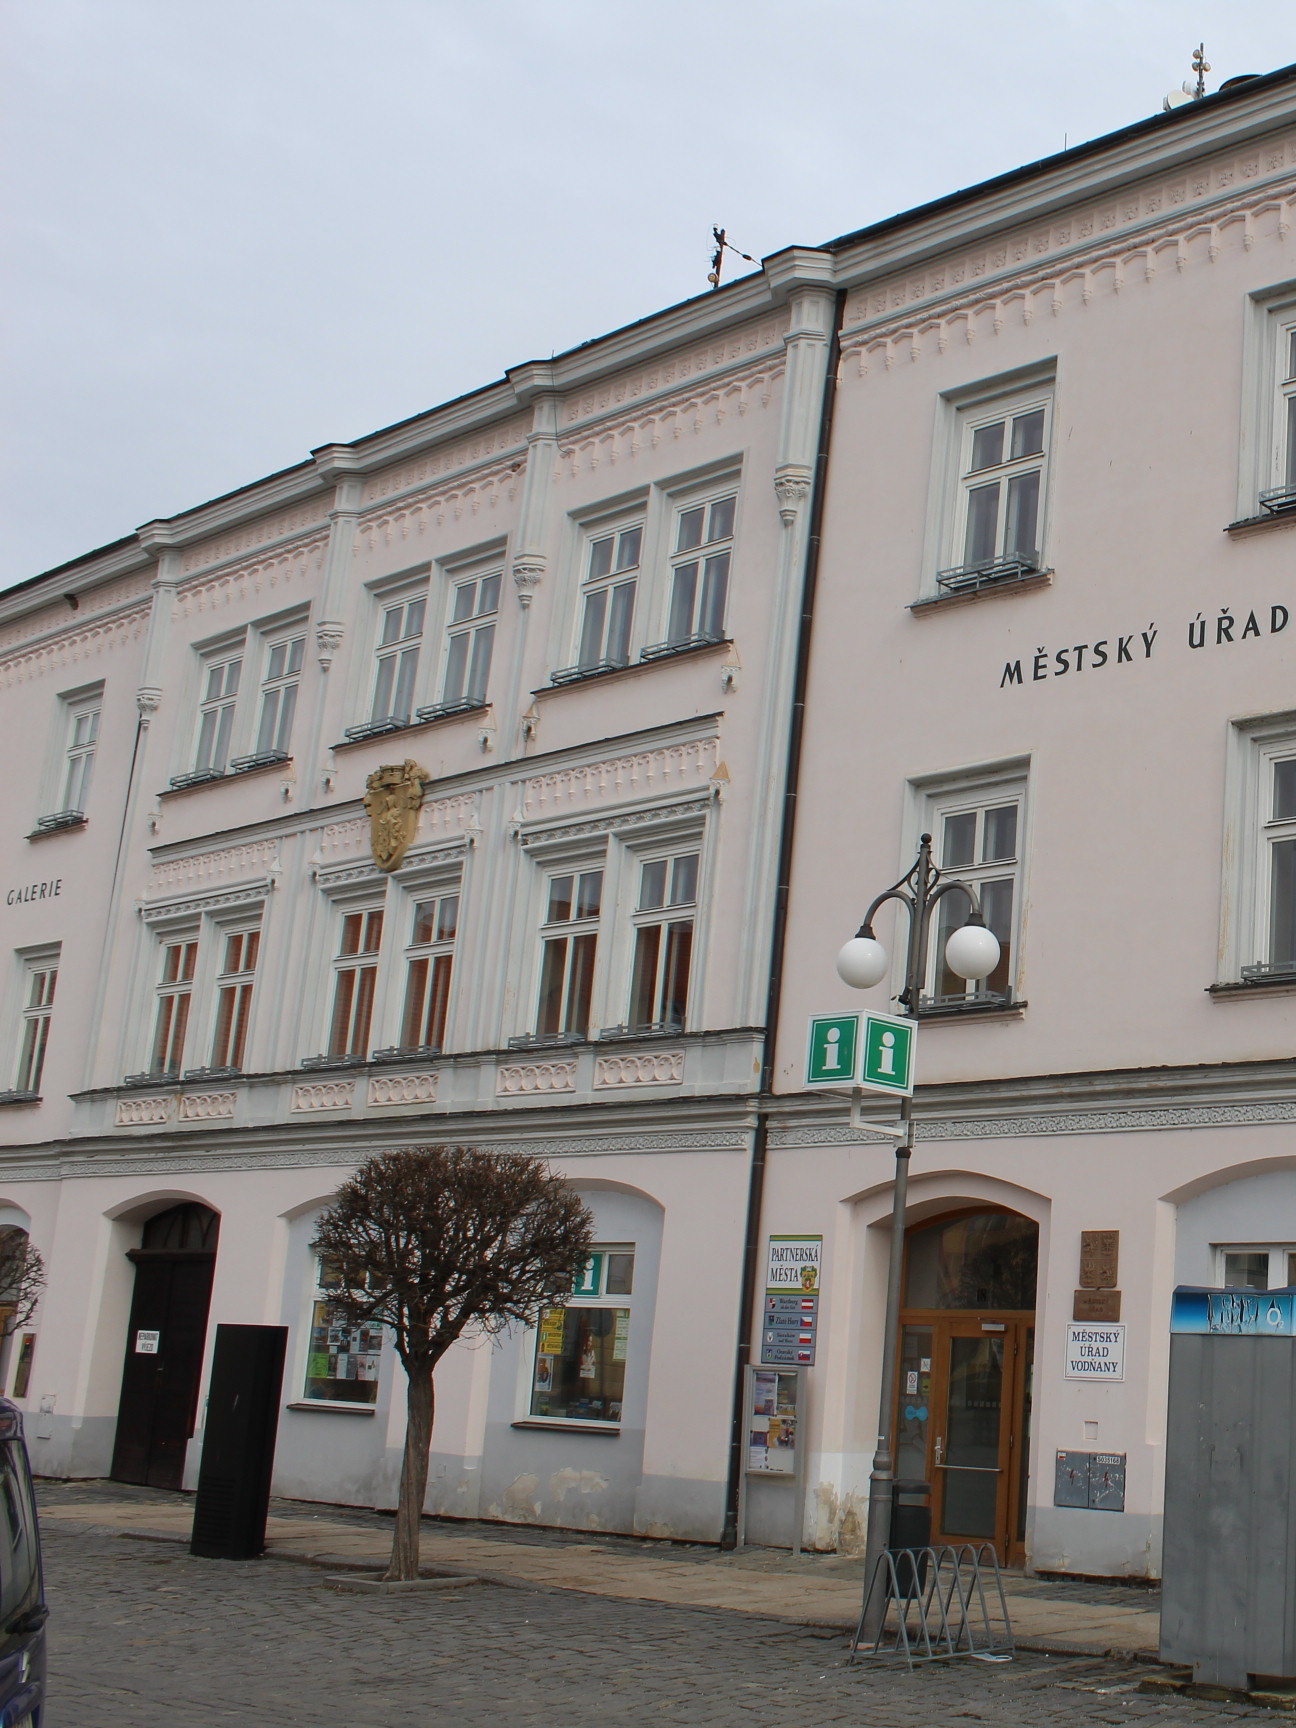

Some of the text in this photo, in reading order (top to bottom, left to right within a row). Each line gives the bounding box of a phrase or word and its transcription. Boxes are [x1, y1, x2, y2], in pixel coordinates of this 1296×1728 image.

[1000, 605, 1289, 688] MĚSTSKÝ ÚŘAD
[7, 879, 62, 905] GALERIE
[771, 1245, 818, 1262] PARTNERSKÁ
[770, 1264, 798, 1282] MĚSTA
[1072, 1329, 1120, 1343] MĚSTSKÝ
[1080, 1344, 1109, 1358] ÚŘAD
[1071, 1358, 1118, 1373] VODŇANY
